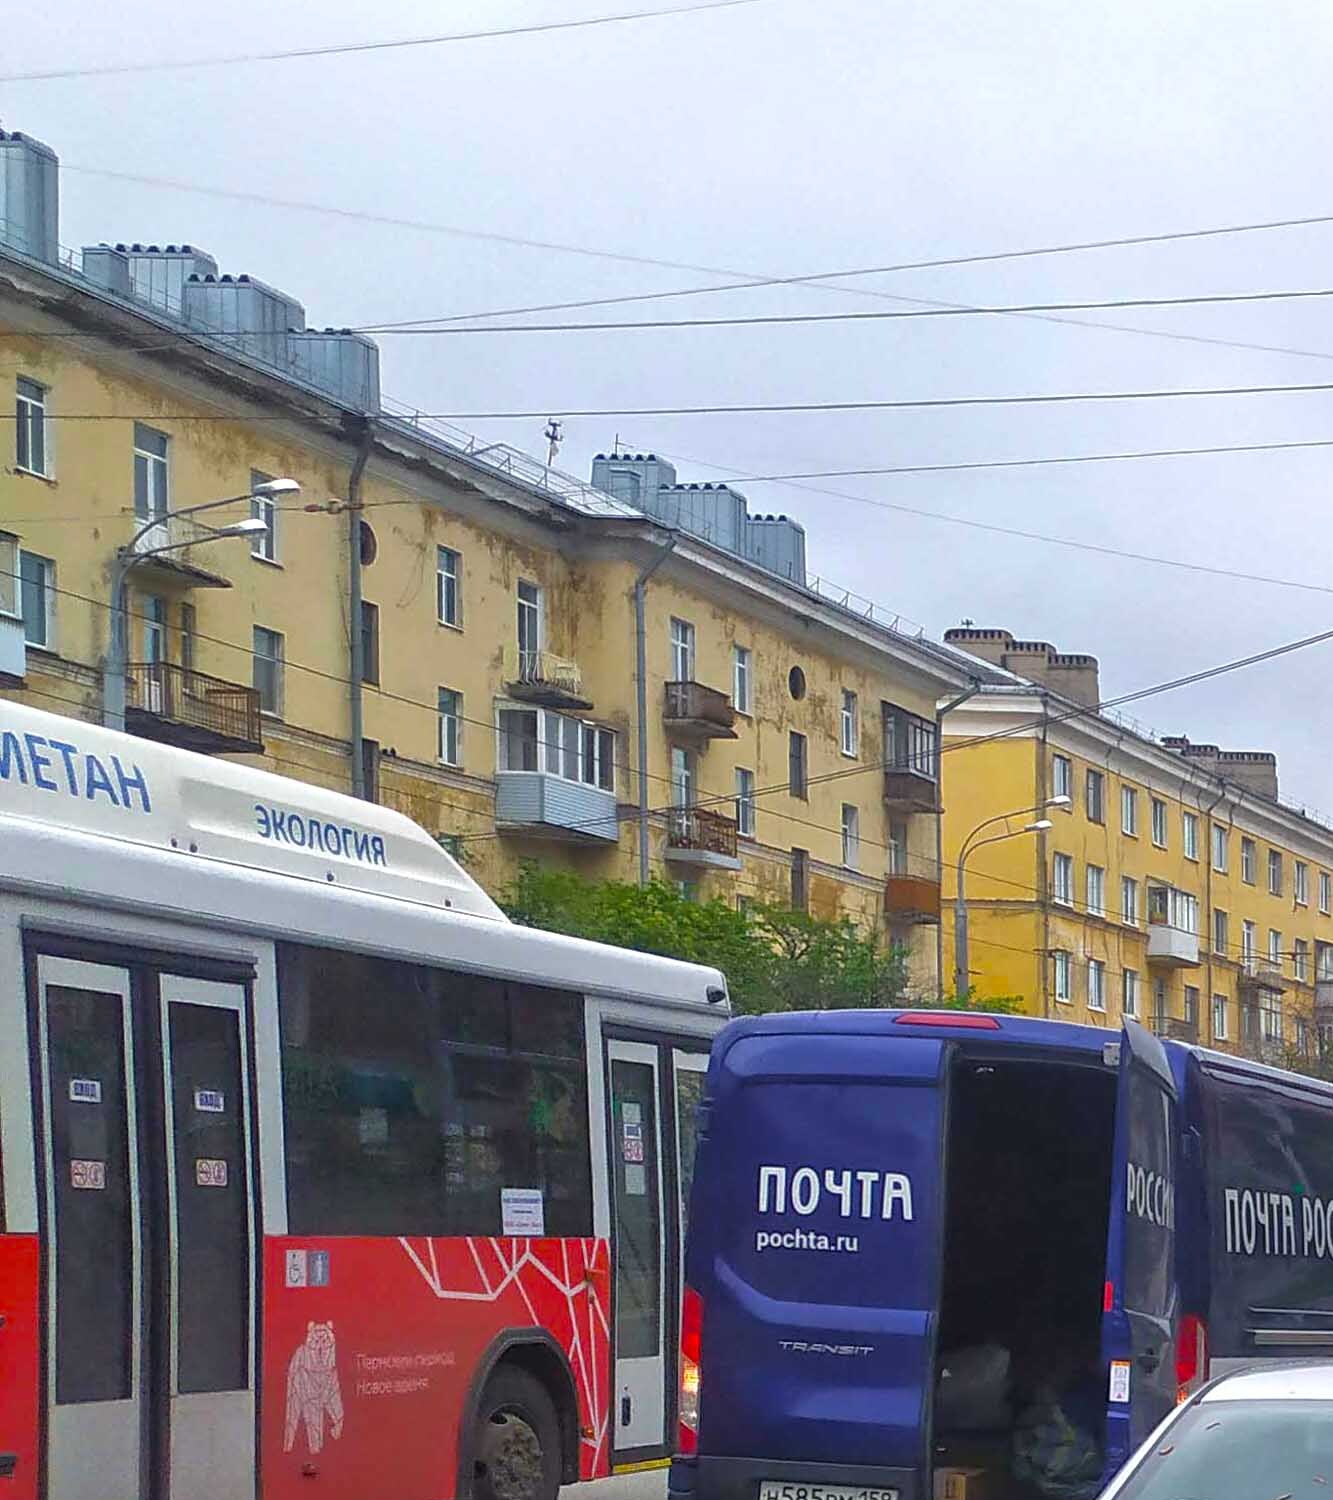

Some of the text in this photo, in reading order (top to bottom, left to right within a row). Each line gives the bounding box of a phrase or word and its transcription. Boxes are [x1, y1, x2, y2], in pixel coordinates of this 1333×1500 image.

[254, 804, 388, 867] ЭКОЛОГИЯ
[758, 1165, 914, 1221] ПОЧТА
[756, 1227, 859, 1252] pochta.ru
[1224, 1187, 1297, 1257] ПОЧТА
[778, 1340, 876, 1356] TRANSIT
